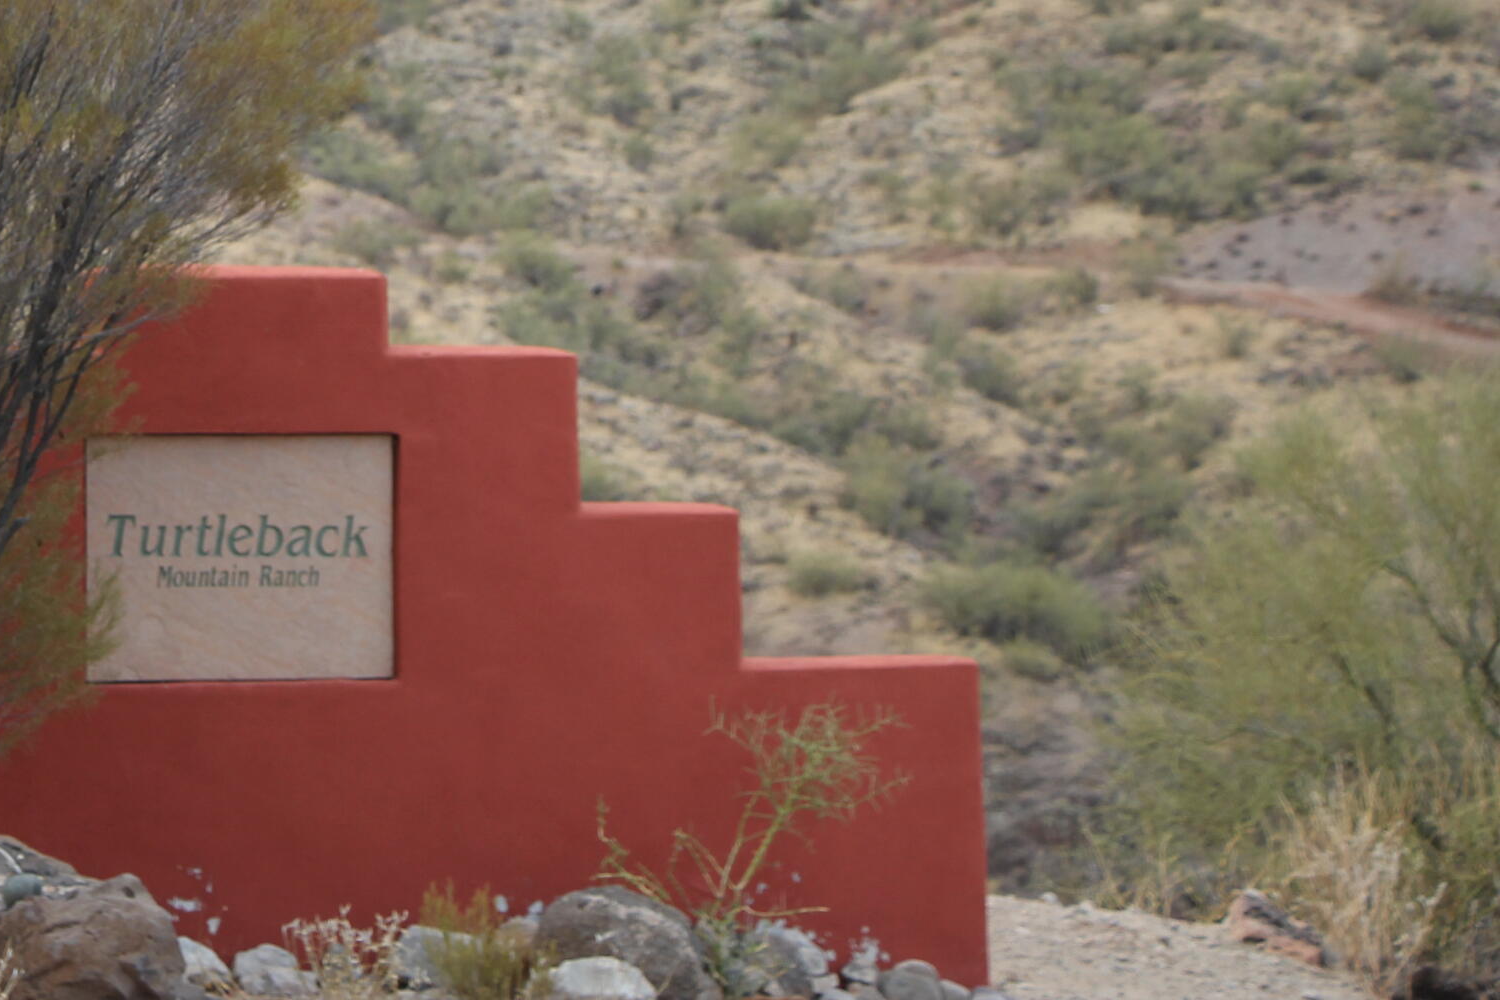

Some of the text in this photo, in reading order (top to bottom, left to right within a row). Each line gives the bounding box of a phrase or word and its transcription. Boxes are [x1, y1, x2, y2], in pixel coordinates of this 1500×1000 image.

[106, 514, 369, 558] Turtleback
[156, 565, 320, 588] Mountain Ranch
